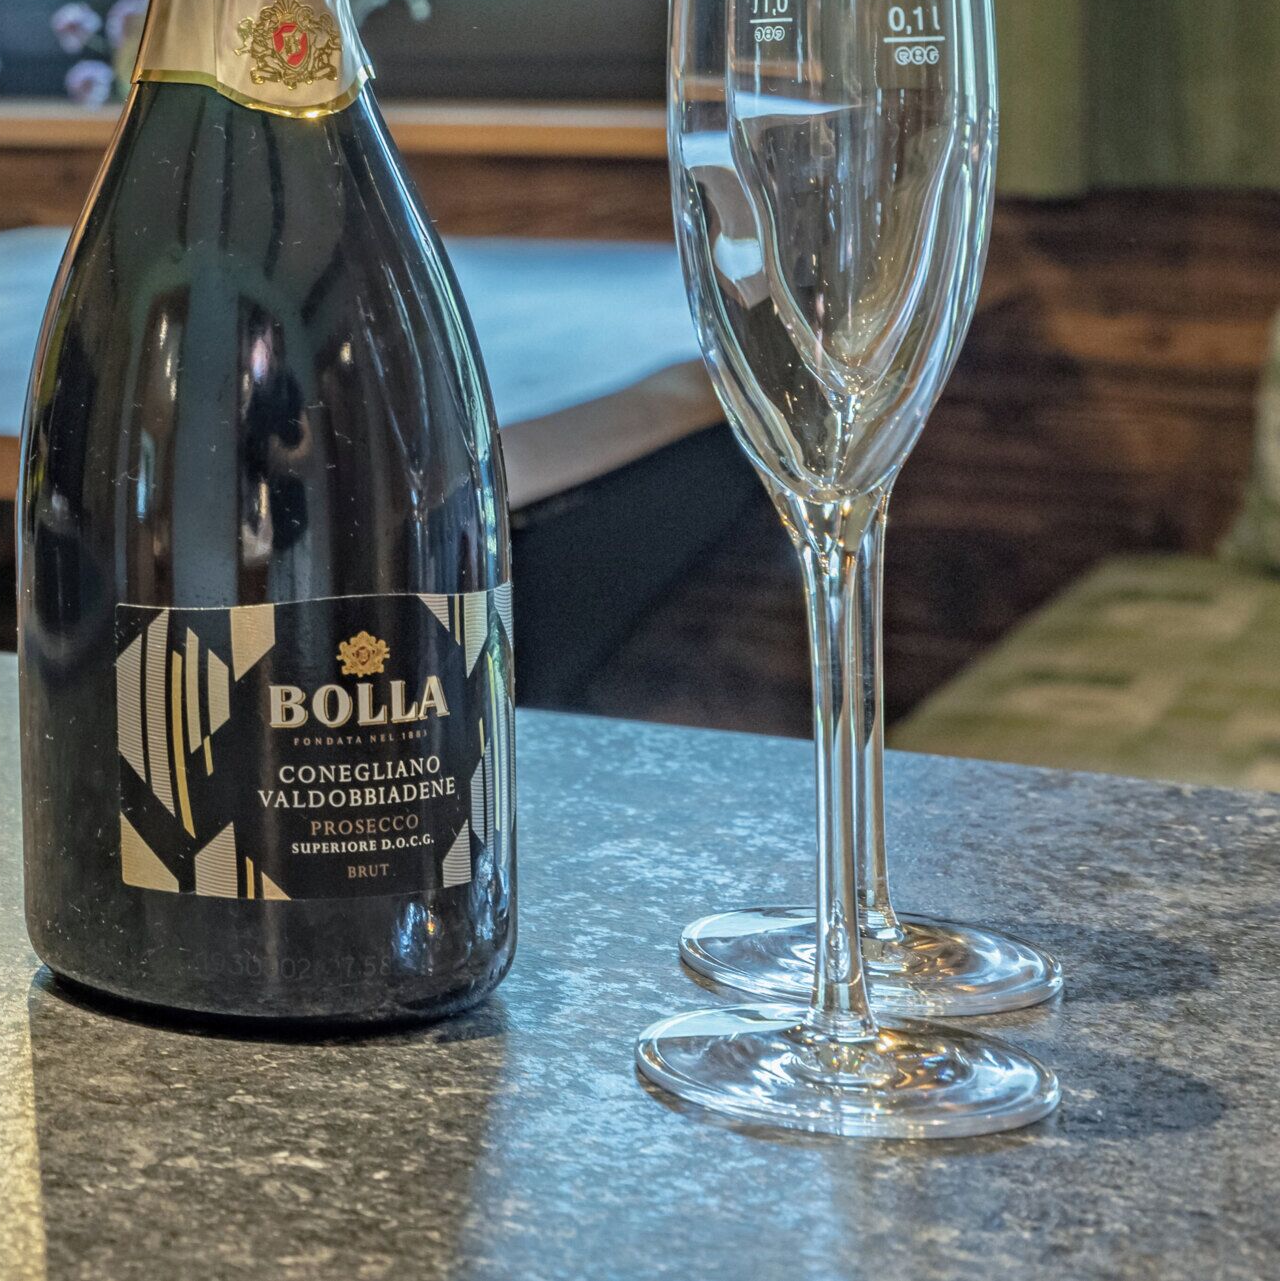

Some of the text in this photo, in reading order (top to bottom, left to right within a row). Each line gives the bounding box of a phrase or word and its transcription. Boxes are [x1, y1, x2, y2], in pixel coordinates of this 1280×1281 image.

[888, 6, 923, 35] 0,1
[268, 674, 451, 728] BOLLA
[293, 735, 362, 746] FONDATA
[369, 733, 394, 743] NEL
[279, 755, 441, 784] CONEGLIANO
[257, 776, 457, 809] VALDOBBIADENE
[310, 813, 420, 837] PROSECCO
[291, 833, 435, 854] SUPERIORE D.O.C.G.
[347, 863, 390, 879] BRUT
